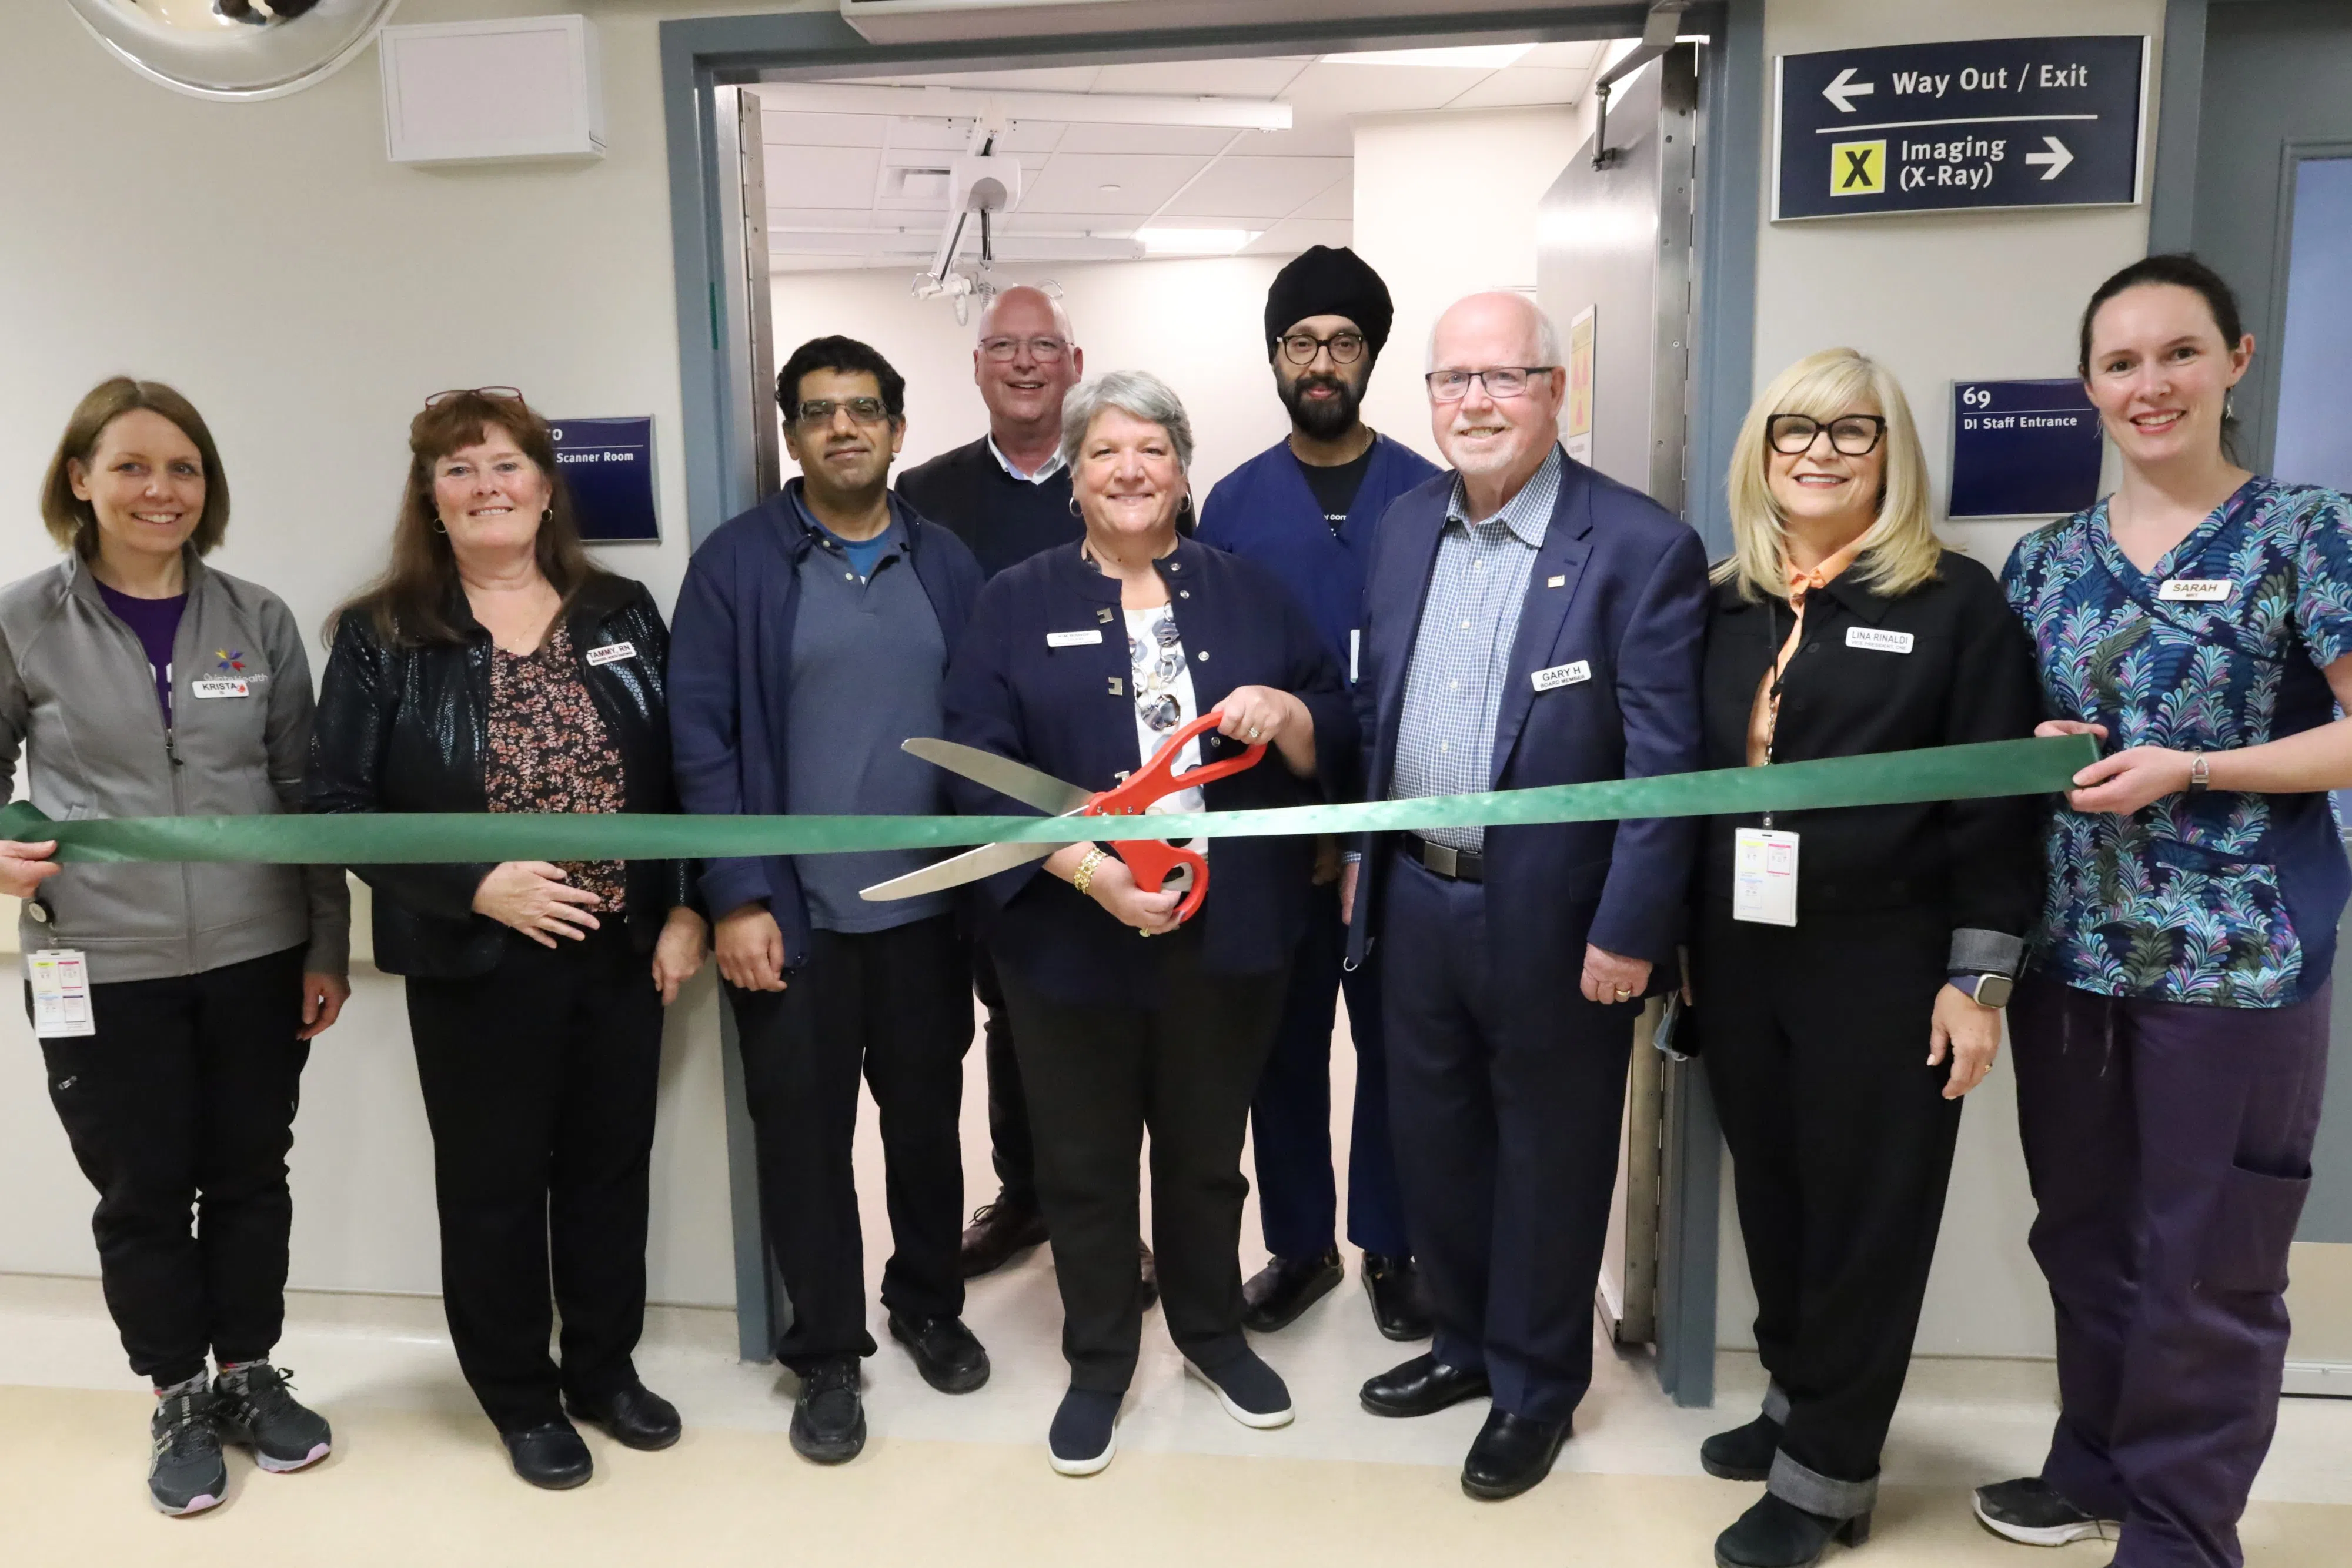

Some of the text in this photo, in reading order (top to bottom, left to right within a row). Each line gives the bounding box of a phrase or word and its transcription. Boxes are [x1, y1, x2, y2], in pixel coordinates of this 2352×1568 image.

[1892, 63, 2088, 98] Way Out / Exit
[1902, 135, 2007, 163] Imaging
[1842, 149, 1873, 188] X
[1900, 161, 1993, 192] (X-Ray)
[1963, 386, 1991, 409] 69
[1964, 416, 2077, 430] DI Staff Entrance
[556, 452, 634, 463] Scanner Room
[2173, 584, 2218, 592] SARAH
[1852, 631, 1908, 644] LINA RINALDI
[1542, 666, 1581, 681] GARY H
[202, 683, 238, 691] KRISTA
[1540, 674, 1585, 688] BOARD MEMBER
